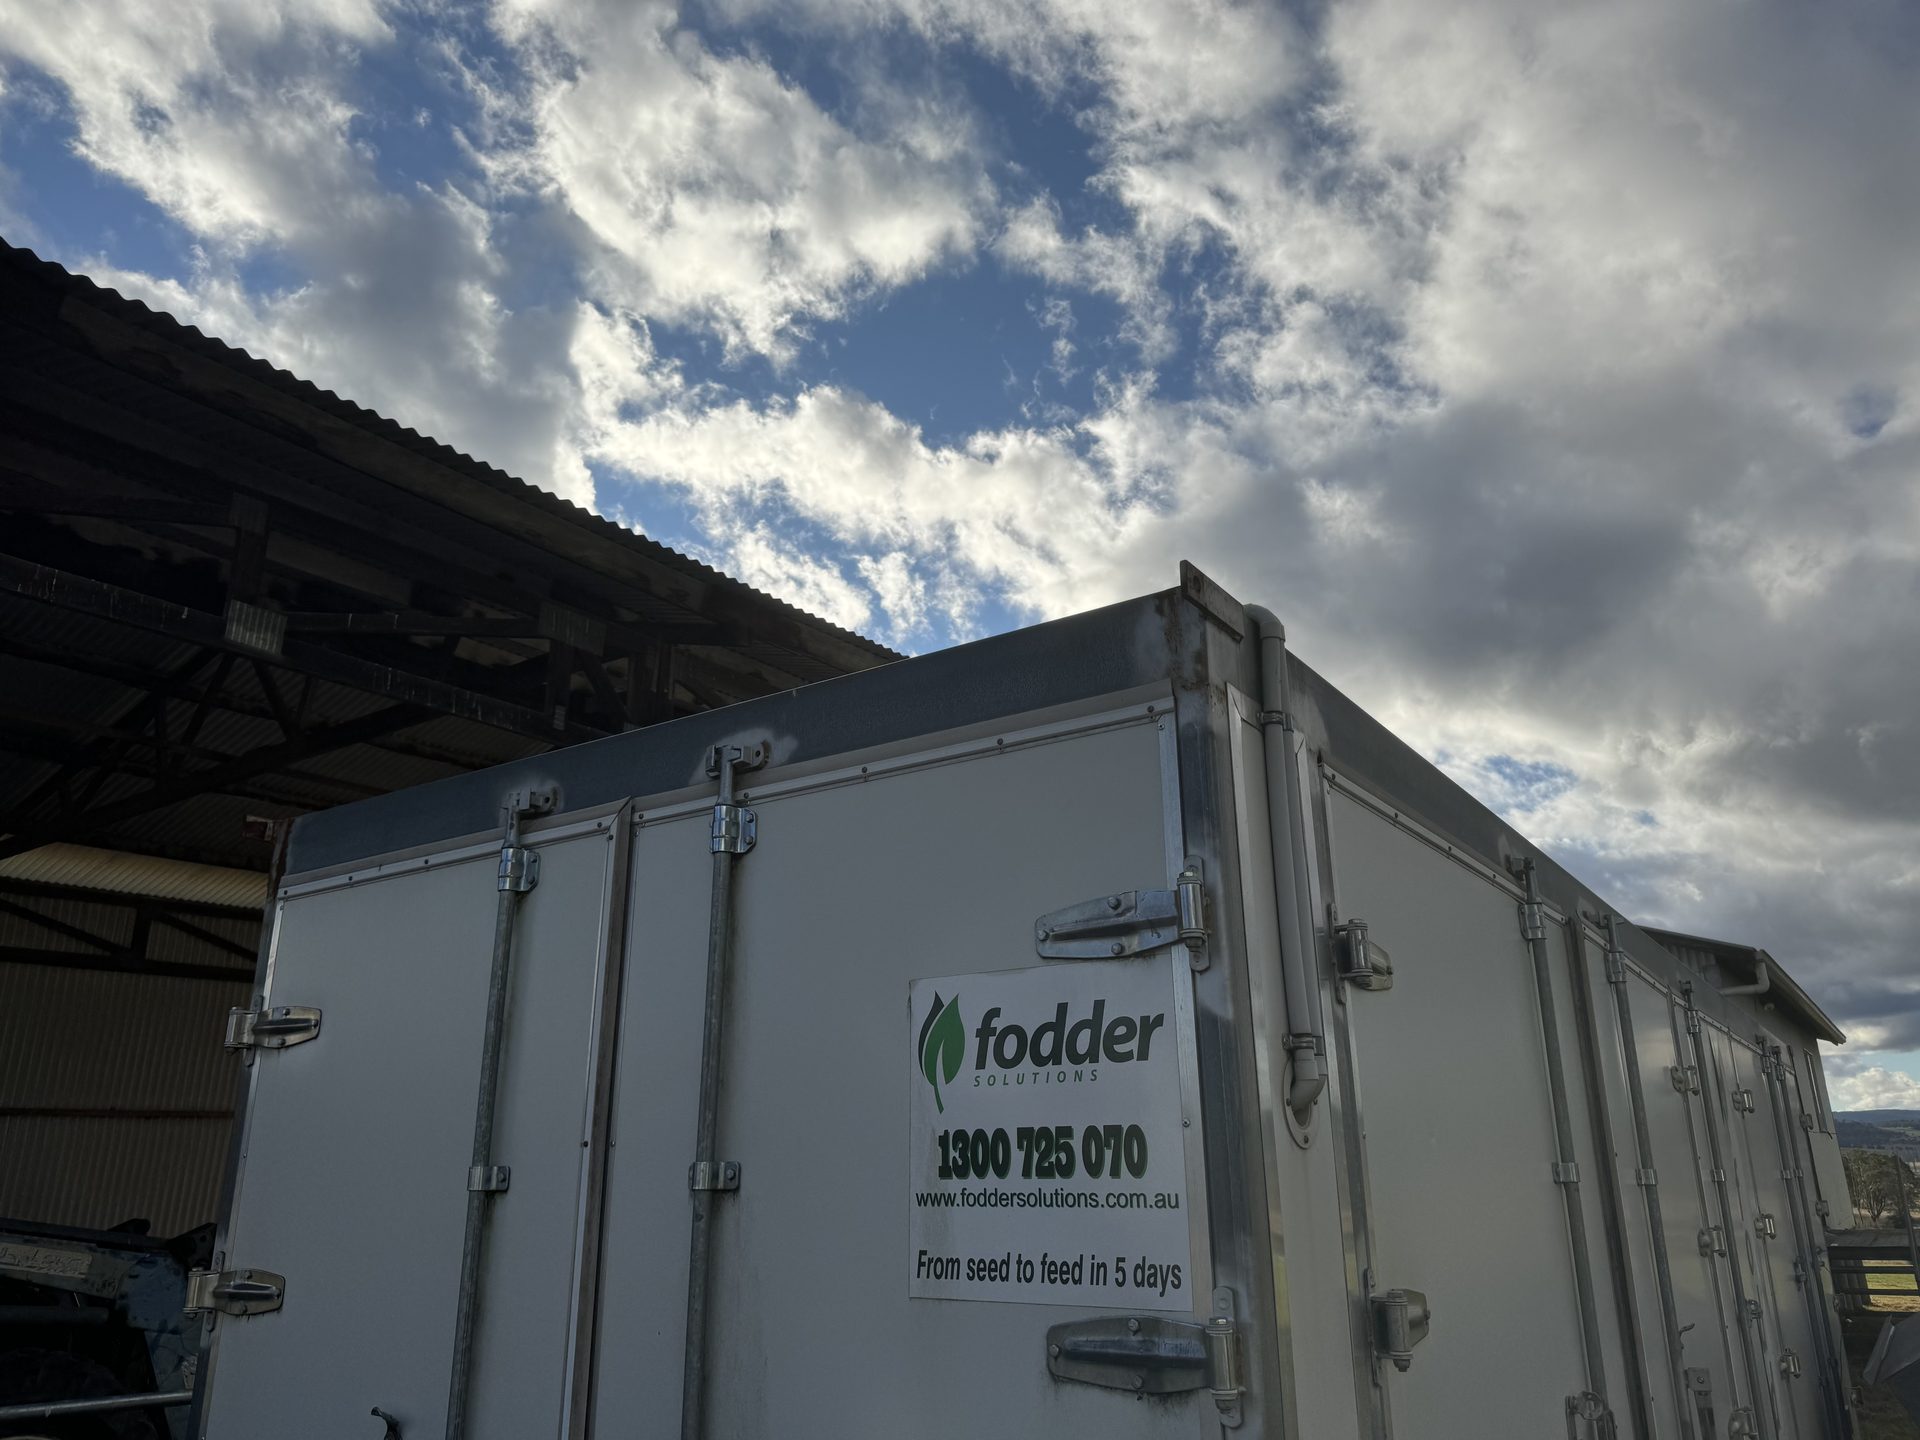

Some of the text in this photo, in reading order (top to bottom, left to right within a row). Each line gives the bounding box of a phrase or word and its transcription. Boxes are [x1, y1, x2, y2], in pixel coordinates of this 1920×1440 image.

[975, 999, 1164, 1070] fodder
[973, 1070, 1098, 1087] SOLUTIONS
[938, 1124, 1148, 1179] 1300 725 070
[916, 1188, 1179, 1208] www.foddersolutions.com.au
[917, 1250, 1181, 1297] From seed to feed in 5 days
